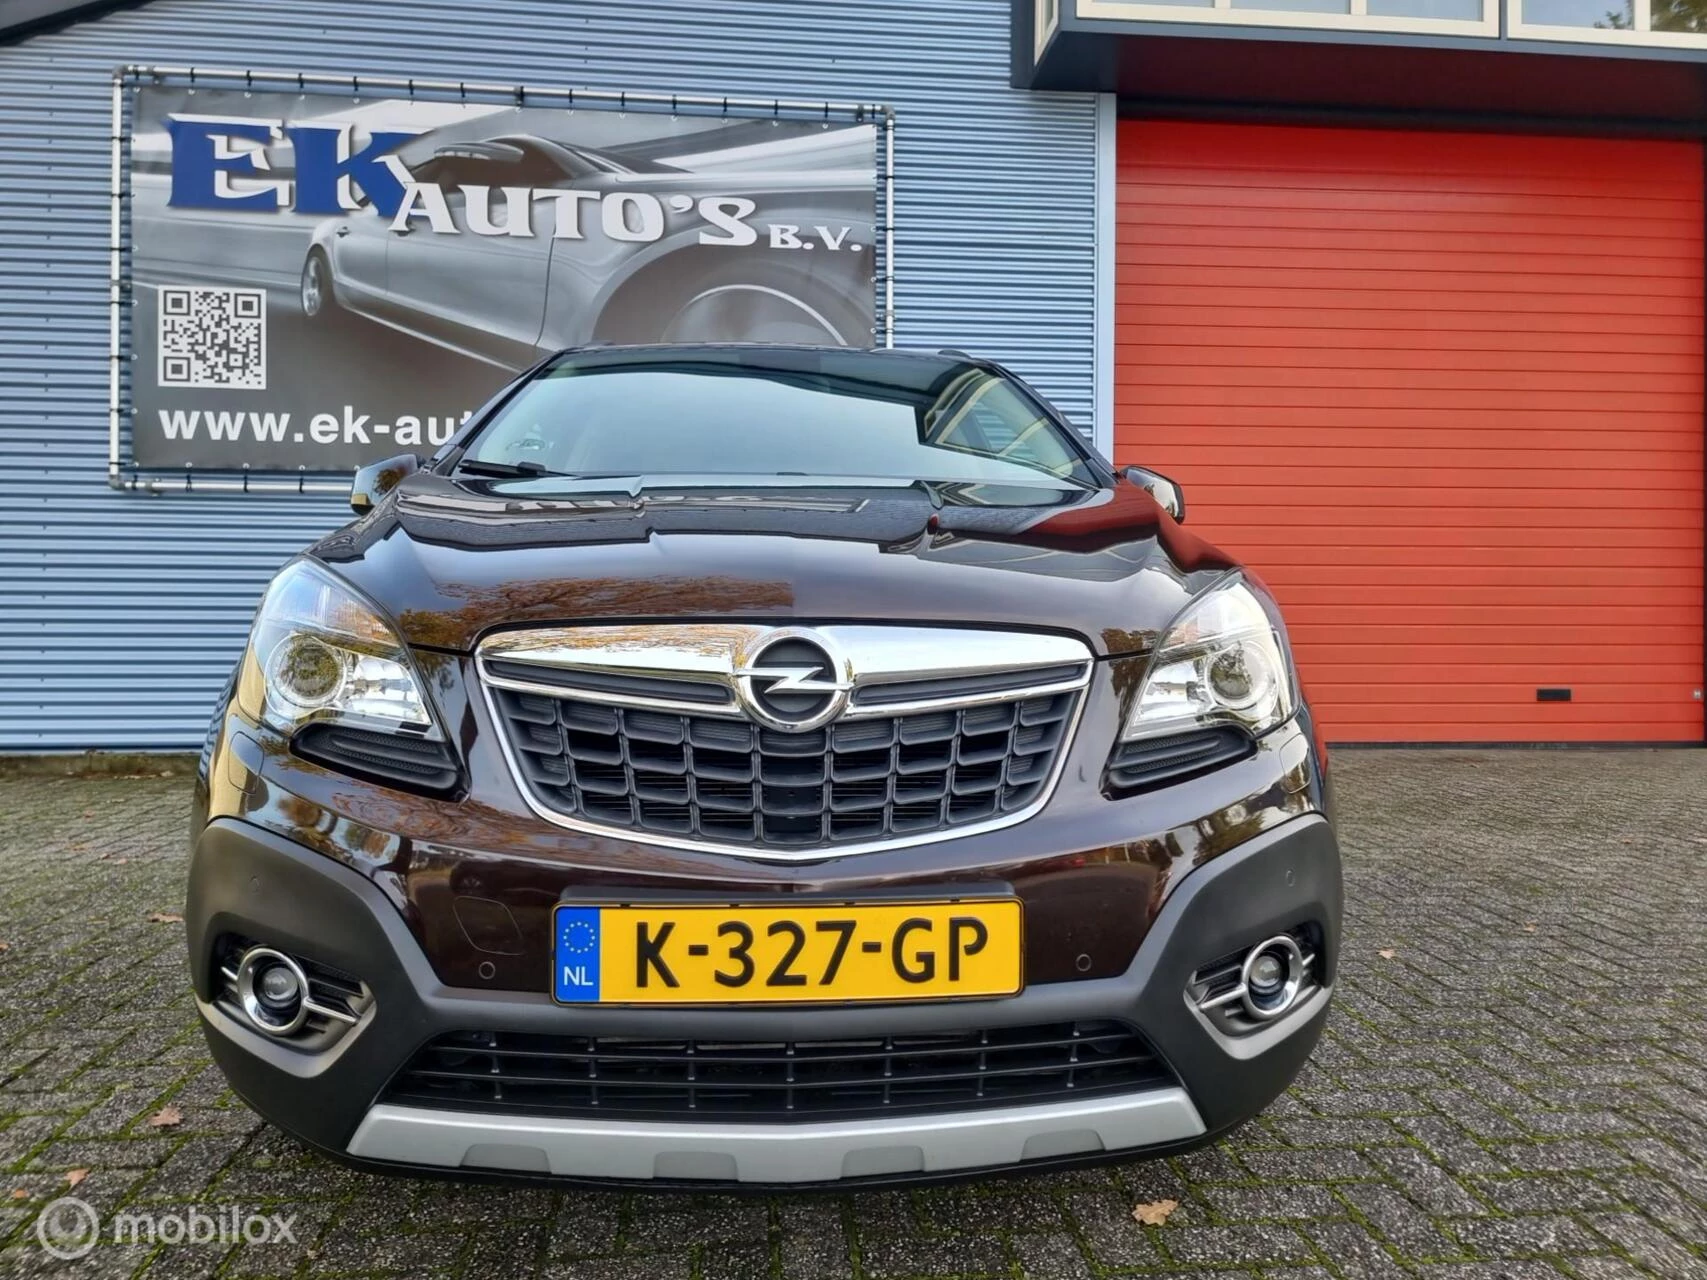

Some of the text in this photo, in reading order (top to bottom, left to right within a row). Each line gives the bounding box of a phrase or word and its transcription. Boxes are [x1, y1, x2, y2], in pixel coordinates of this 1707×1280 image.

[161, 113, 862, 252] EK AUTO'S B.V.
[563, 965, 594, 987] NL
[636, 916, 988, 988] K-327-GP
